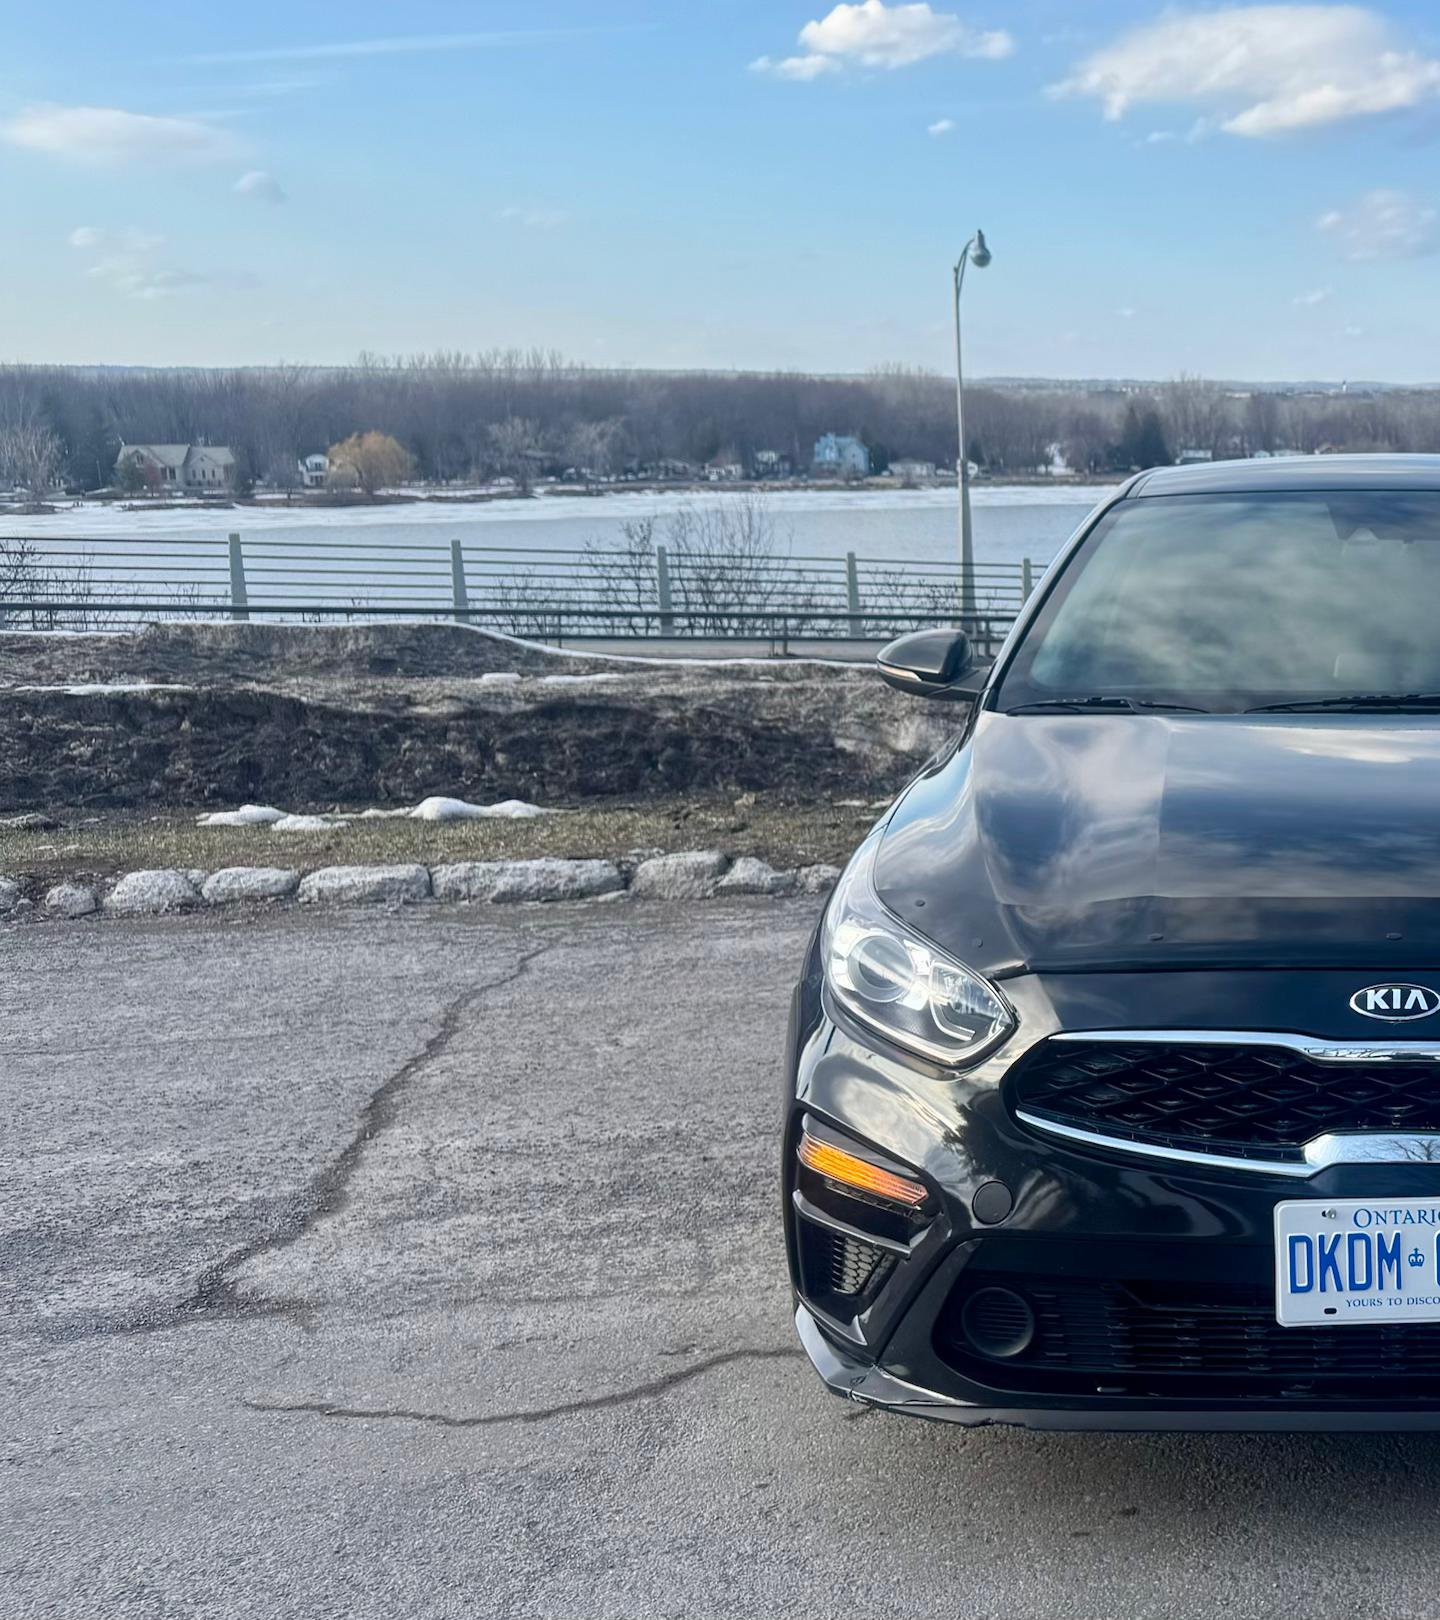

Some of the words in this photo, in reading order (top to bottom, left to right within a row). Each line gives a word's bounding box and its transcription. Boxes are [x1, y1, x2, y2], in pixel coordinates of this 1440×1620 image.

[1366, 988, 1429, 1011] KIA
[1287, 1232, 1403, 1294] DKDM
[1346, 1298, 1383, 1308] YOURS
[1387, 1297, 1403, 1306] TO
